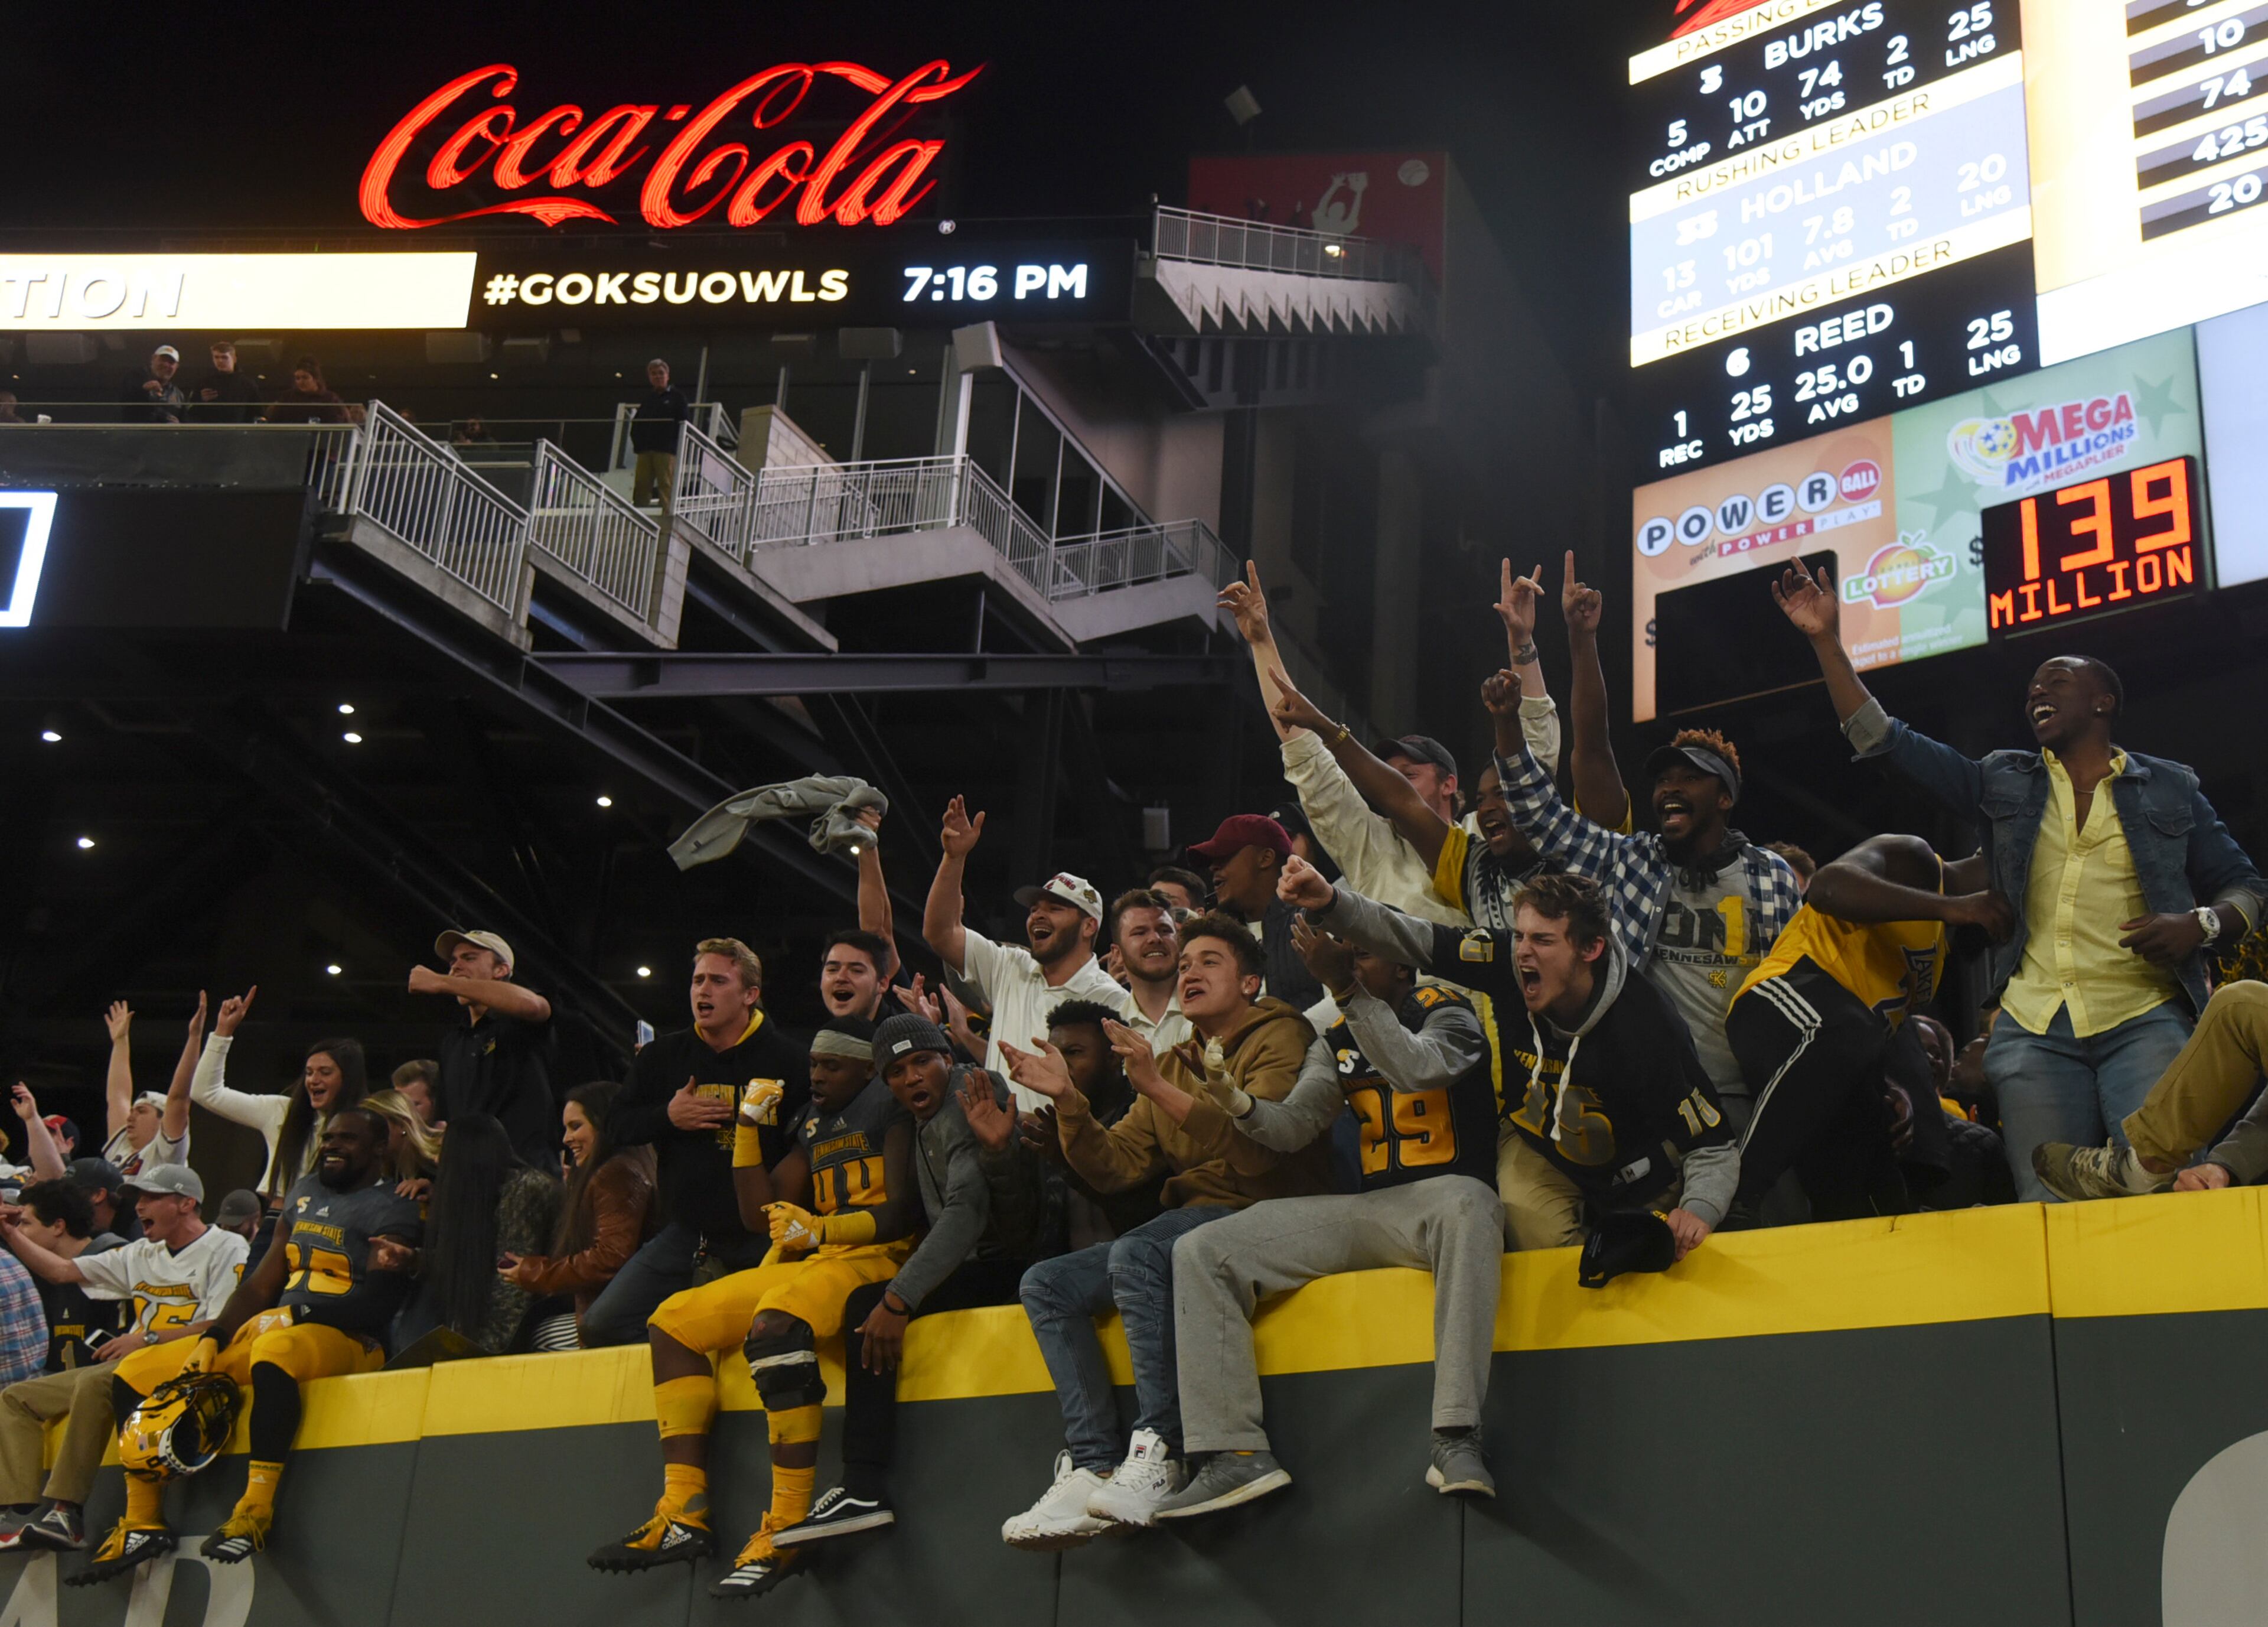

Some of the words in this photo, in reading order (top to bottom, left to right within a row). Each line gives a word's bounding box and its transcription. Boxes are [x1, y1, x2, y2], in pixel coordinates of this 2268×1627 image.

[1677, 1, 1794, 58] PASSING
[1700, 64, 1723, 94] 3
[1765, 2, 1884, 70] BURKS
[2198, 18, 2245, 54] 10
[1649, 142, 1710, 177] COMP
[1728, 118, 1771, 149] ATT
[1800, 91, 1846, 121] YDS
[1882, 66, 1915, 90] TD
[1946, 34, 1996, 67] LNG
[1668, 119, 1687, 147] 5
[1729, 90, 1767, 123] 10
[1798, 60, 1842, 97] 74
[1886, 35, 1909, 66] 2
[1948, 1, 1993, 41] 25
[2199, 68, 2251, 109] 74
[359, 59, 990, 229] Coca-Cola
[1676, 140, 1800, 201] RUSHING
[1811, 92, 1930, 151] LEADER
[2192, 116, 2268, 161] 425
[1741, 141, 1918, 224] HOLLAND
[2208, 174, 2262, 214] 20
[1657, 290, 1702, 319] CAR
[1725, 267, 1770, 295] YDS
[1802, 239, 1854, 271] AVG
[1886, 217, 1919, 241] TD
[1960, 186, 2013, 217] LNG
[1662, 260, 1696, 292] 13
[1723, 232, 1773, 271] 101
[1801, 206, 1855, 245] 7.8
[1889, 186, 1912, 216] 2
[1957, 152, 2007, 194] 20
[482, 269, 849, 308] #GOKSUOWLS
[902, 265, 998, 301] 7:16
[1015, 264, 1088, 299] PM
[1665, 284, 1819, 350] RECEIVING
[1831, 239, 1952, 297] LEADER
[1674, 411, 1687, 438] 1
[1730, 385, 1772, 422] 25
[1794, 354, 1873, 402] 25.0
[1899, 340, 1914, 369] 1
[1966, 310, 2014, 350] 25
[1726, 347, 1750, 378] 6
[1795, 302, 1894, 357] REED
[1659, 440, 1703, 468] REC
[1728, 419, 1774, 446] YDS
[1807, 393, 1859, 425] AVG
[1892, 375, 1925, 398] TD
[1968, 344, 2021, 376] LNG
[2009, 394, 2134, 460] MEGA
[2006, 423, 2135, 486] MILLIONS
[2044, 445, 2124, 483] MEGAPLIER
[1645, 477, 1827, 551] POWER
[1840, 469, 1877, 494] BALL
[1722, 524, 1806, 554] POWER
[1821, 506, 1871, 529] PLAY
[2020, 458, 2191, 581] 139
[1849, 557, 1949, 597] LOTTERY
[1969, 535, 1983, 567] $
[1990, 546, 2193, 629] MILLION
[1347, 1088, 1456, 1176] 29
[1677, 1086, 1721, 1137] 15
[784, 1228, 809, 1242] adidas
[662, 1532, 692, 1549] adidas
